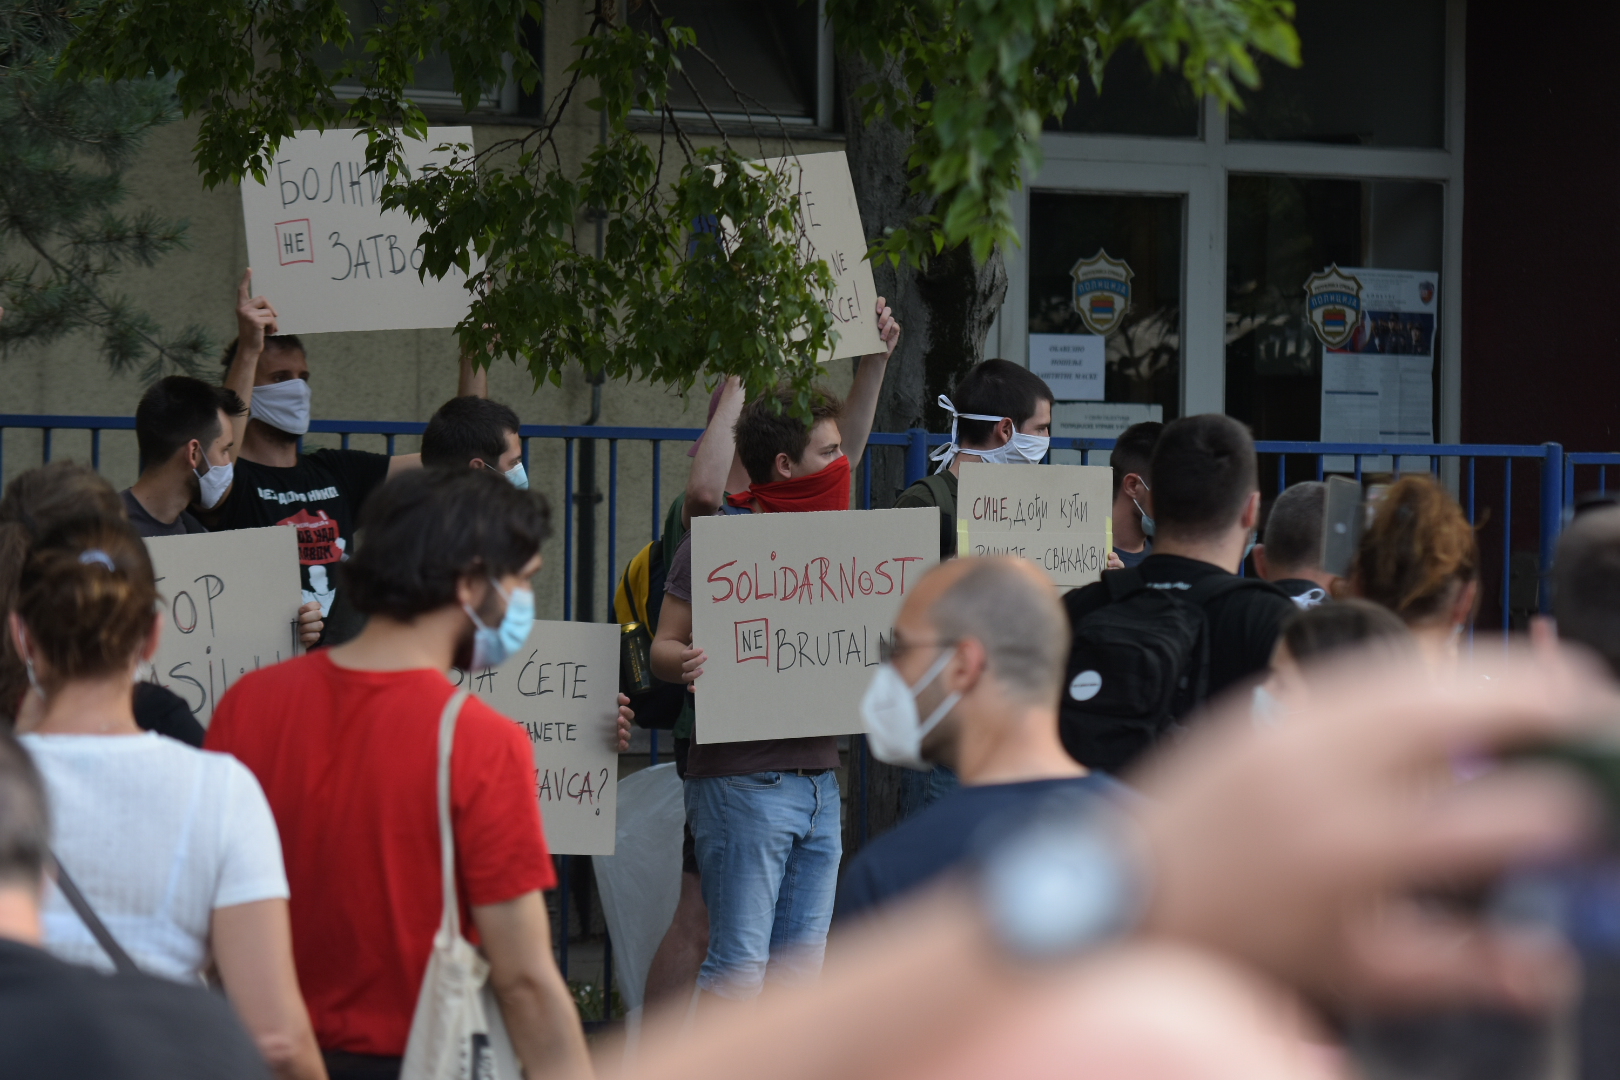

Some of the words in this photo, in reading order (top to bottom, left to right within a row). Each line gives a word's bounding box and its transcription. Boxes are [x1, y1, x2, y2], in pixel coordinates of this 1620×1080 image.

[277, 159, 438, 209] БОЛНИ
[283, 232, 305, 255] НЕ
[328, 231, 456, 281] ЗАТВО
[1078, 279, 1127, 295] ПОЛИЦИЈА
[1311, 293, 1357, 309] ПОЛИЦИЈА
[742, 629, 763, 652] NE
[517, 649, 588, 699] ĆETE
